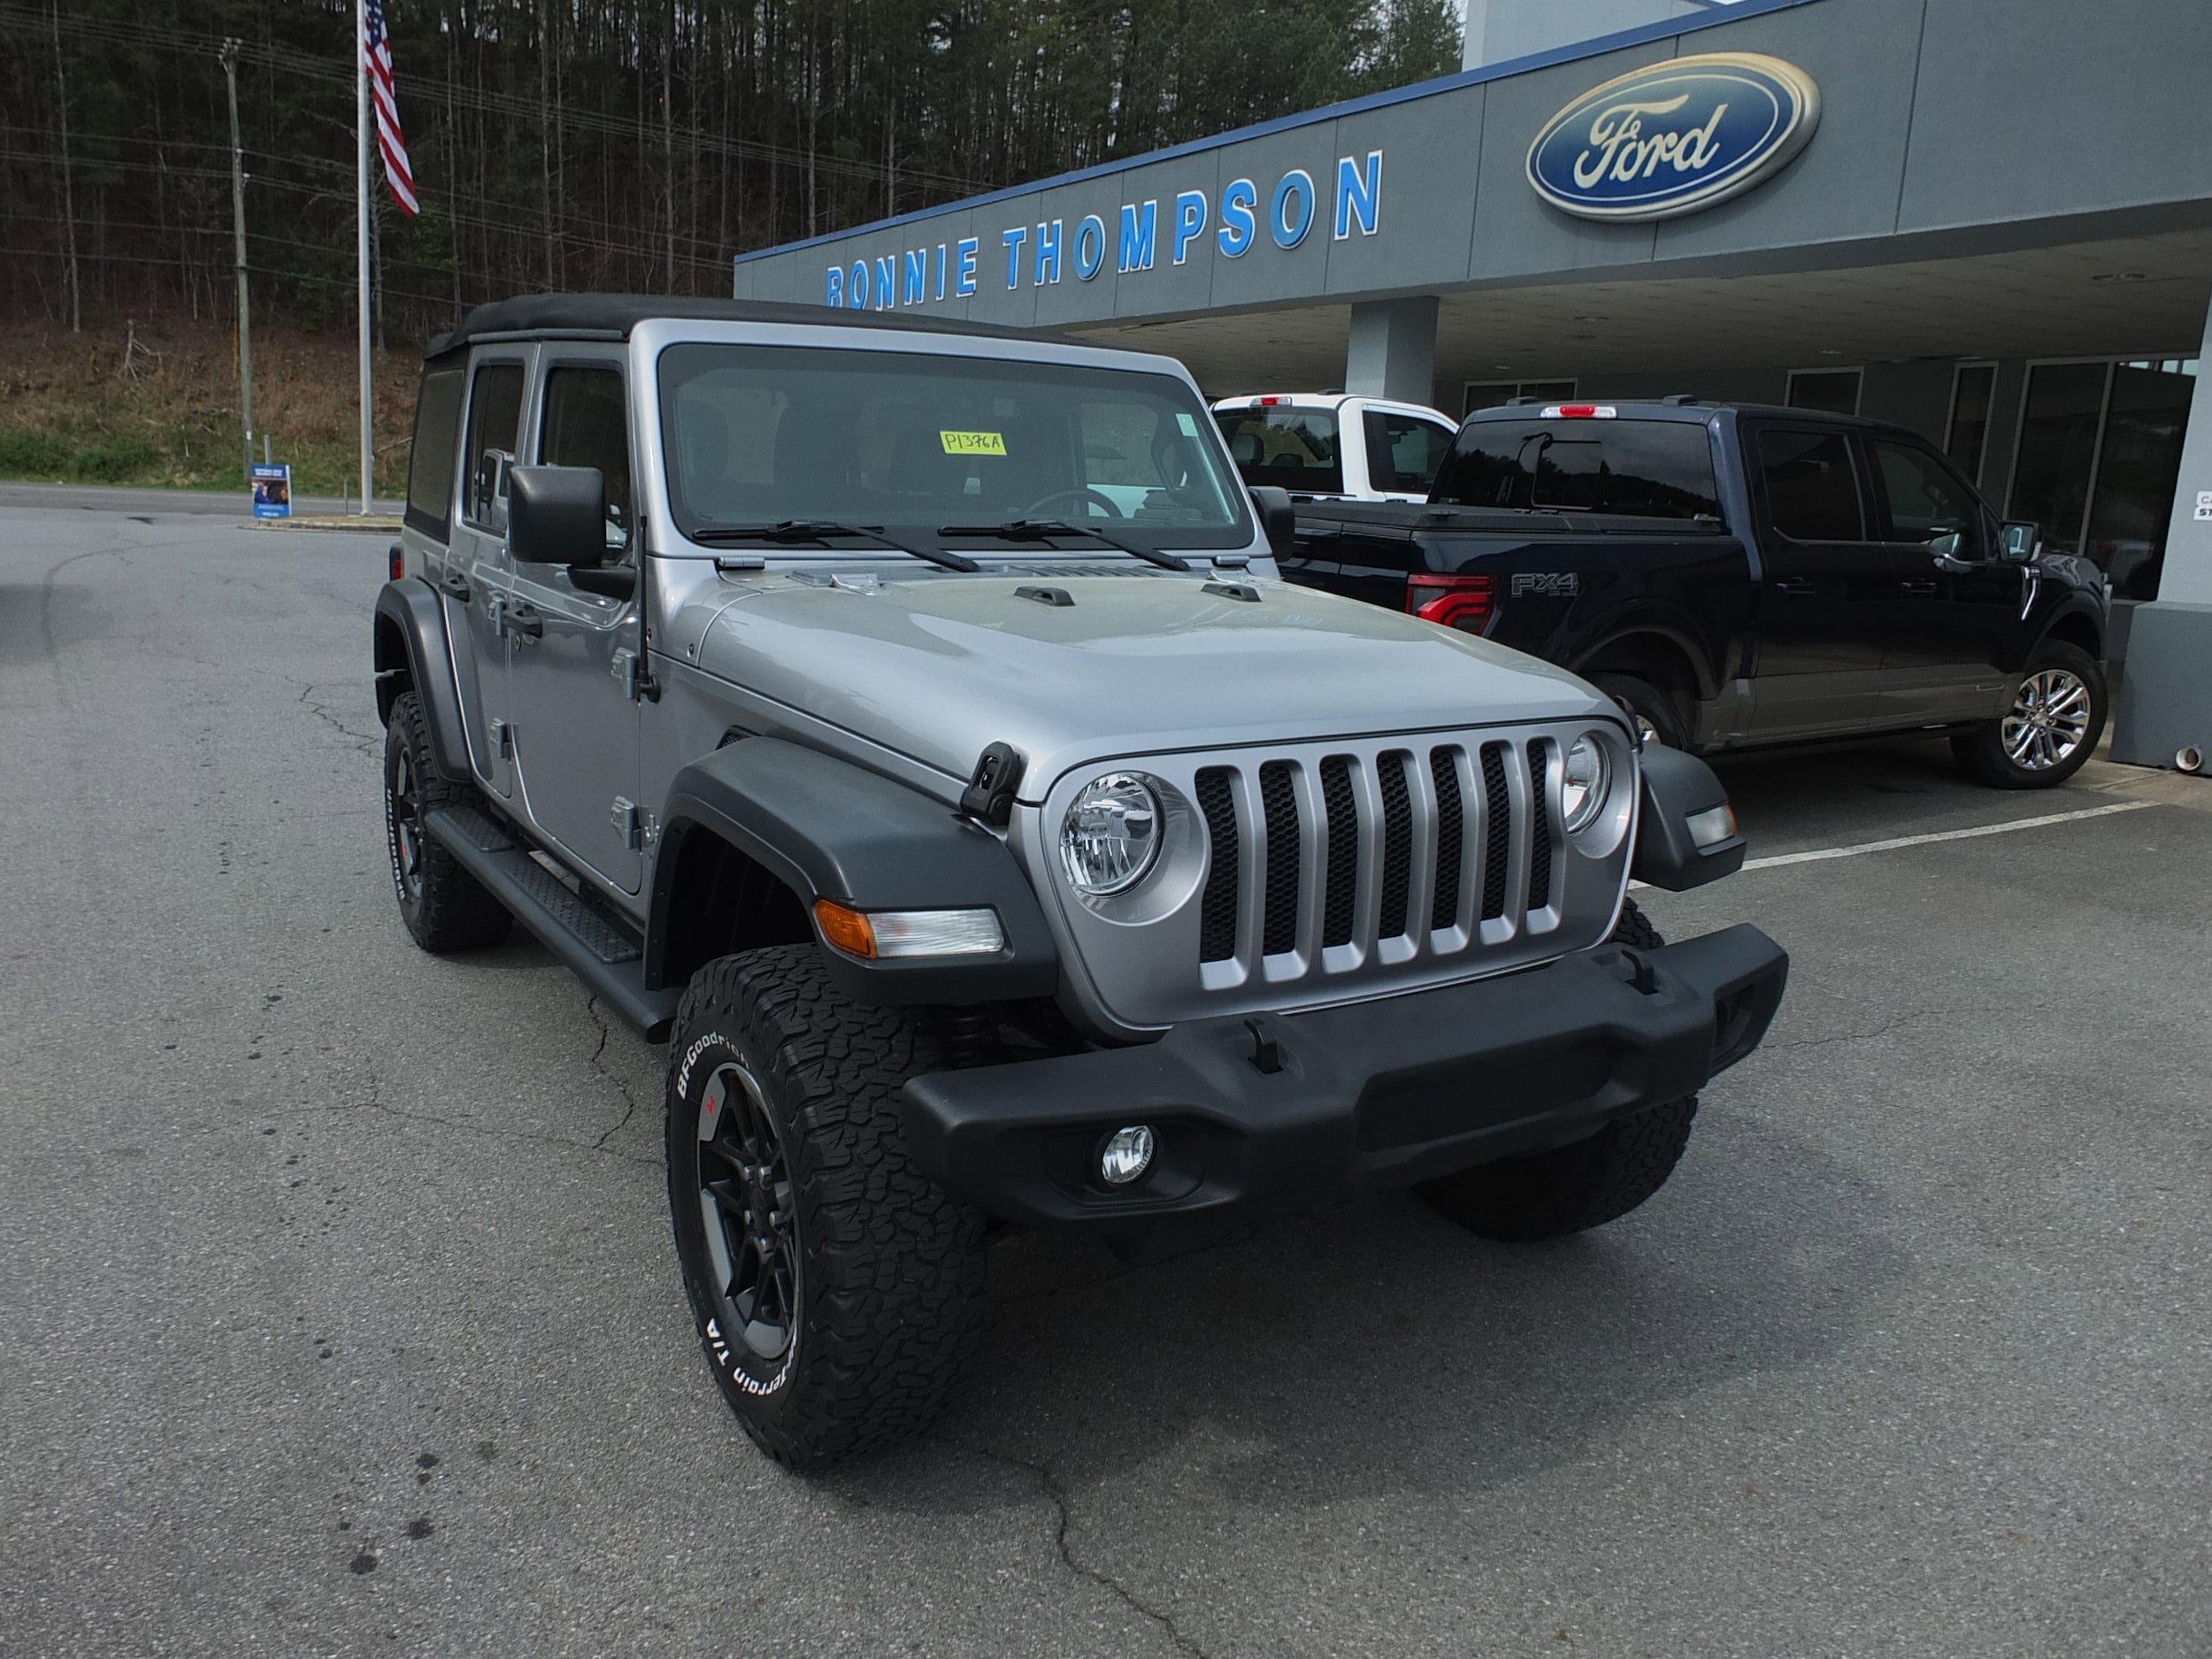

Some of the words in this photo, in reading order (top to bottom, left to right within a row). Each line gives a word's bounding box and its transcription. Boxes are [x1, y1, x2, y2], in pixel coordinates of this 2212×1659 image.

[1573, 93, 1729, 188] Ford
[826, 235, 979, 311] RONNIE
[1002, 149, 1384, 291] THOMPSON
[945, 433, 1001, 450] P1376A
[1510, 572, 1579, 598] FX4
[706, 1317, 731, 1376] T/A
